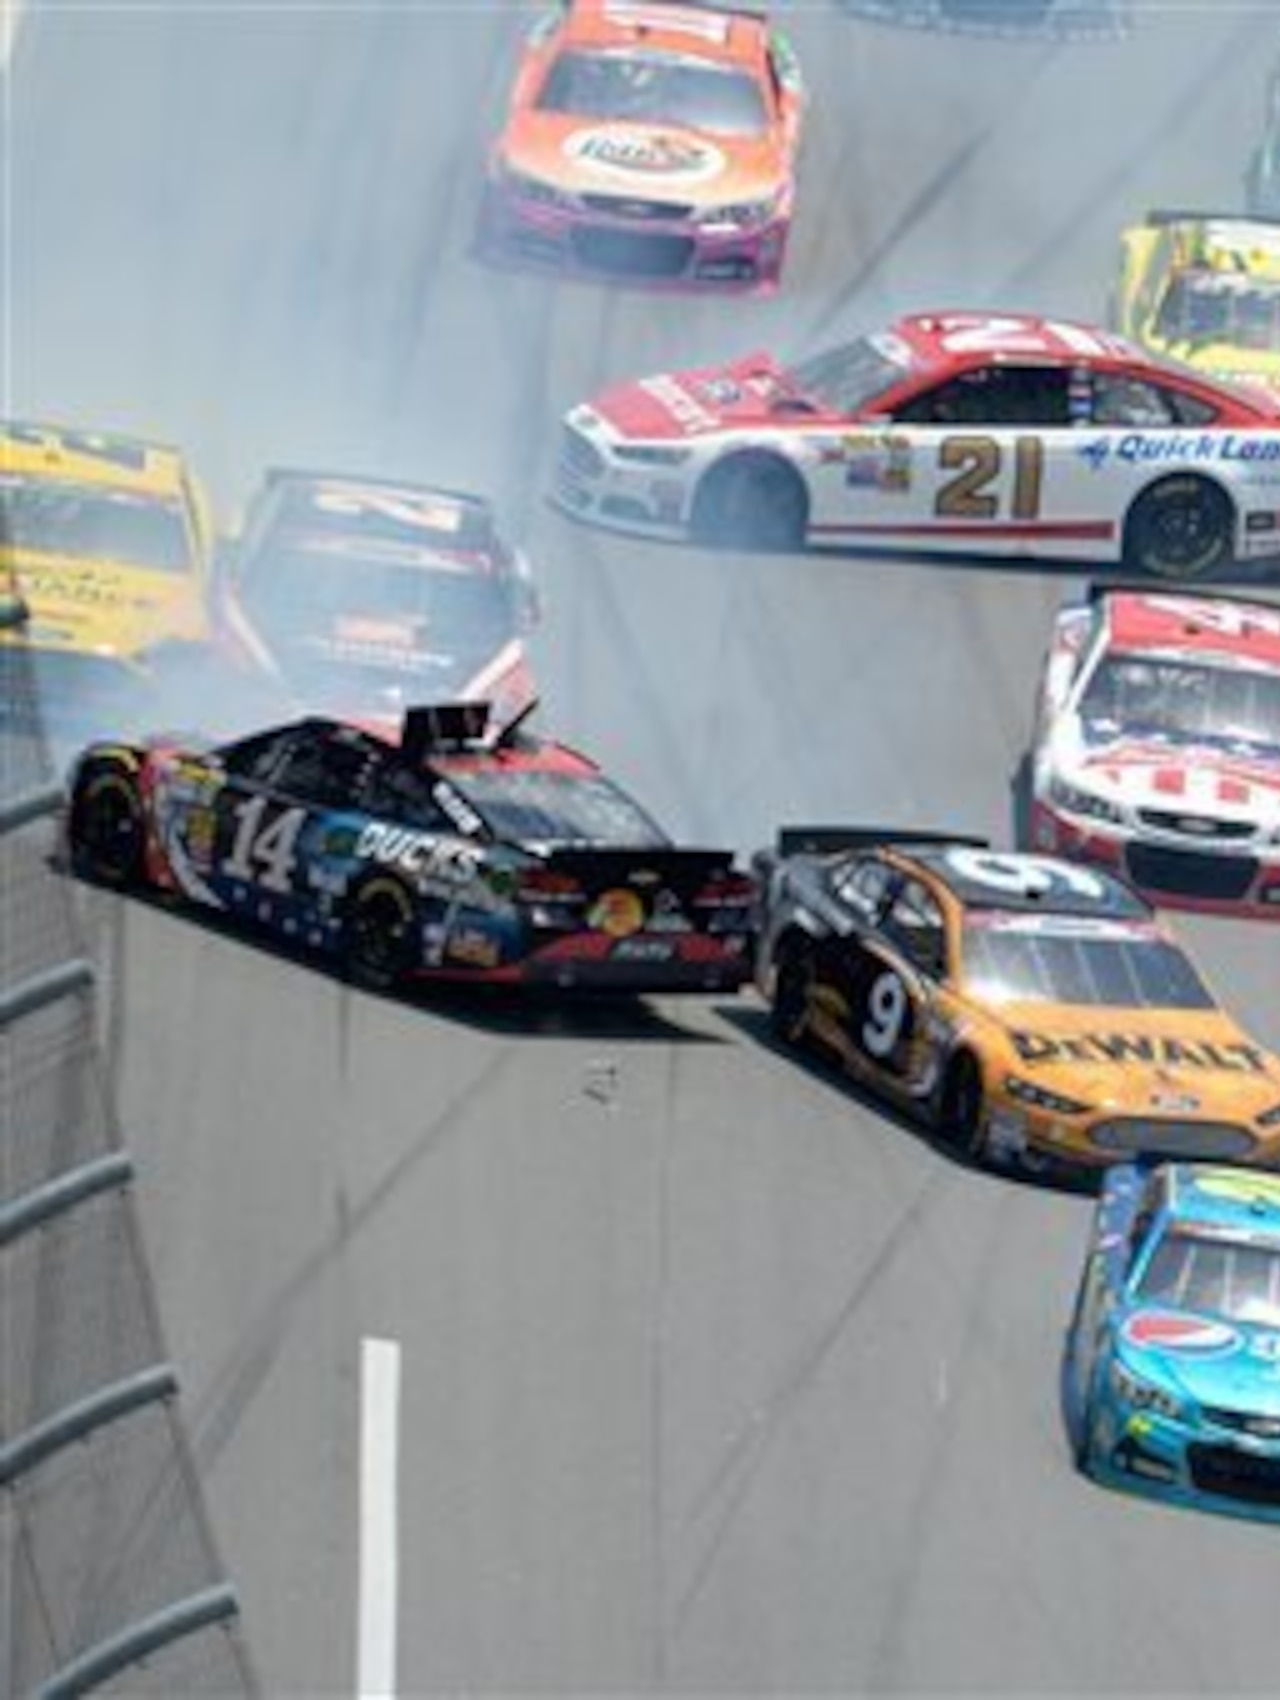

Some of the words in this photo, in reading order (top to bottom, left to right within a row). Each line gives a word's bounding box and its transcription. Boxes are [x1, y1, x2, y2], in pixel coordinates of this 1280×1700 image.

[935, 434, 1045, 521] 21
[1116, 434, 1215, 462] Quick
[220, 795, 307, 894] 14
[861, 970, 905, 1057] 9
